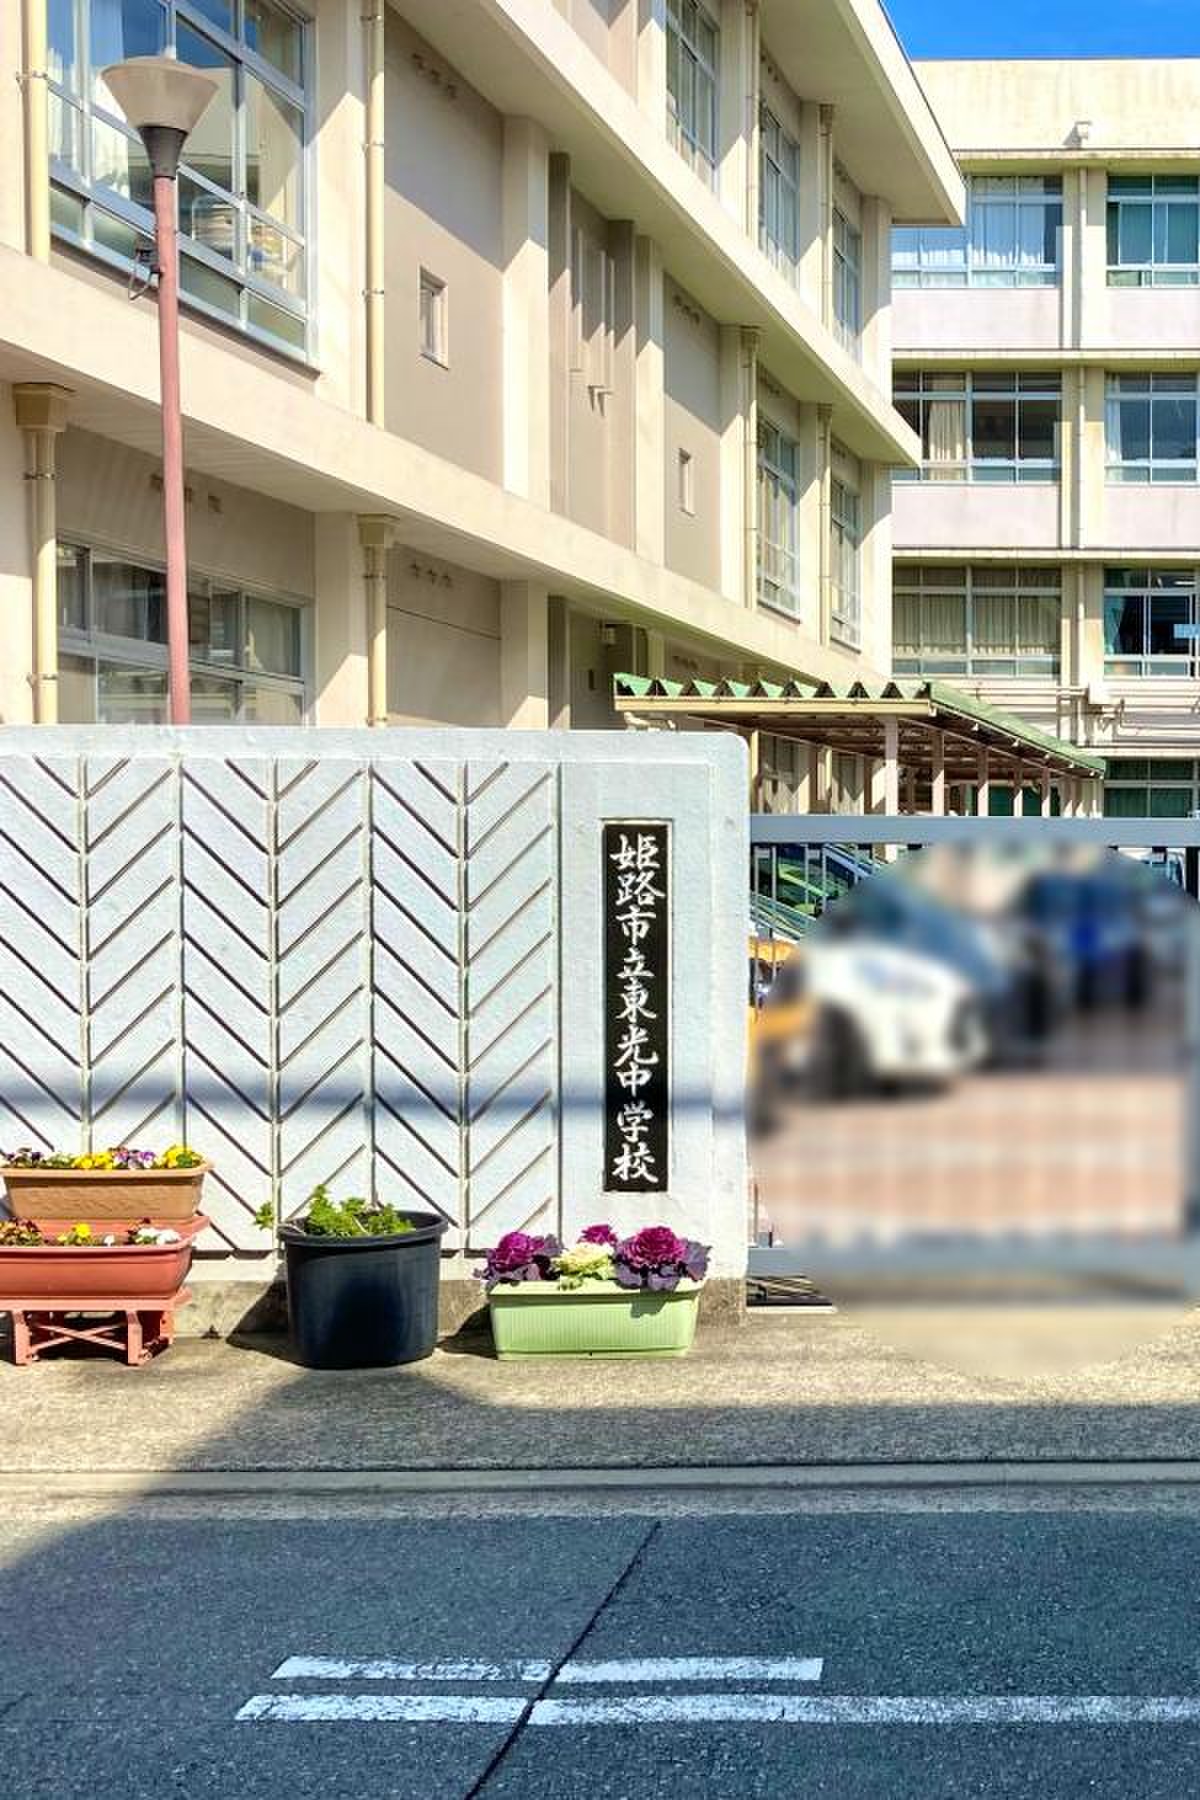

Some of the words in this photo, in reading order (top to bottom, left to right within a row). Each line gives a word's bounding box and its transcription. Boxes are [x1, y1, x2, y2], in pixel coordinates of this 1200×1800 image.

[611, 833, 665, 1183] 姫路市立東光中学校
